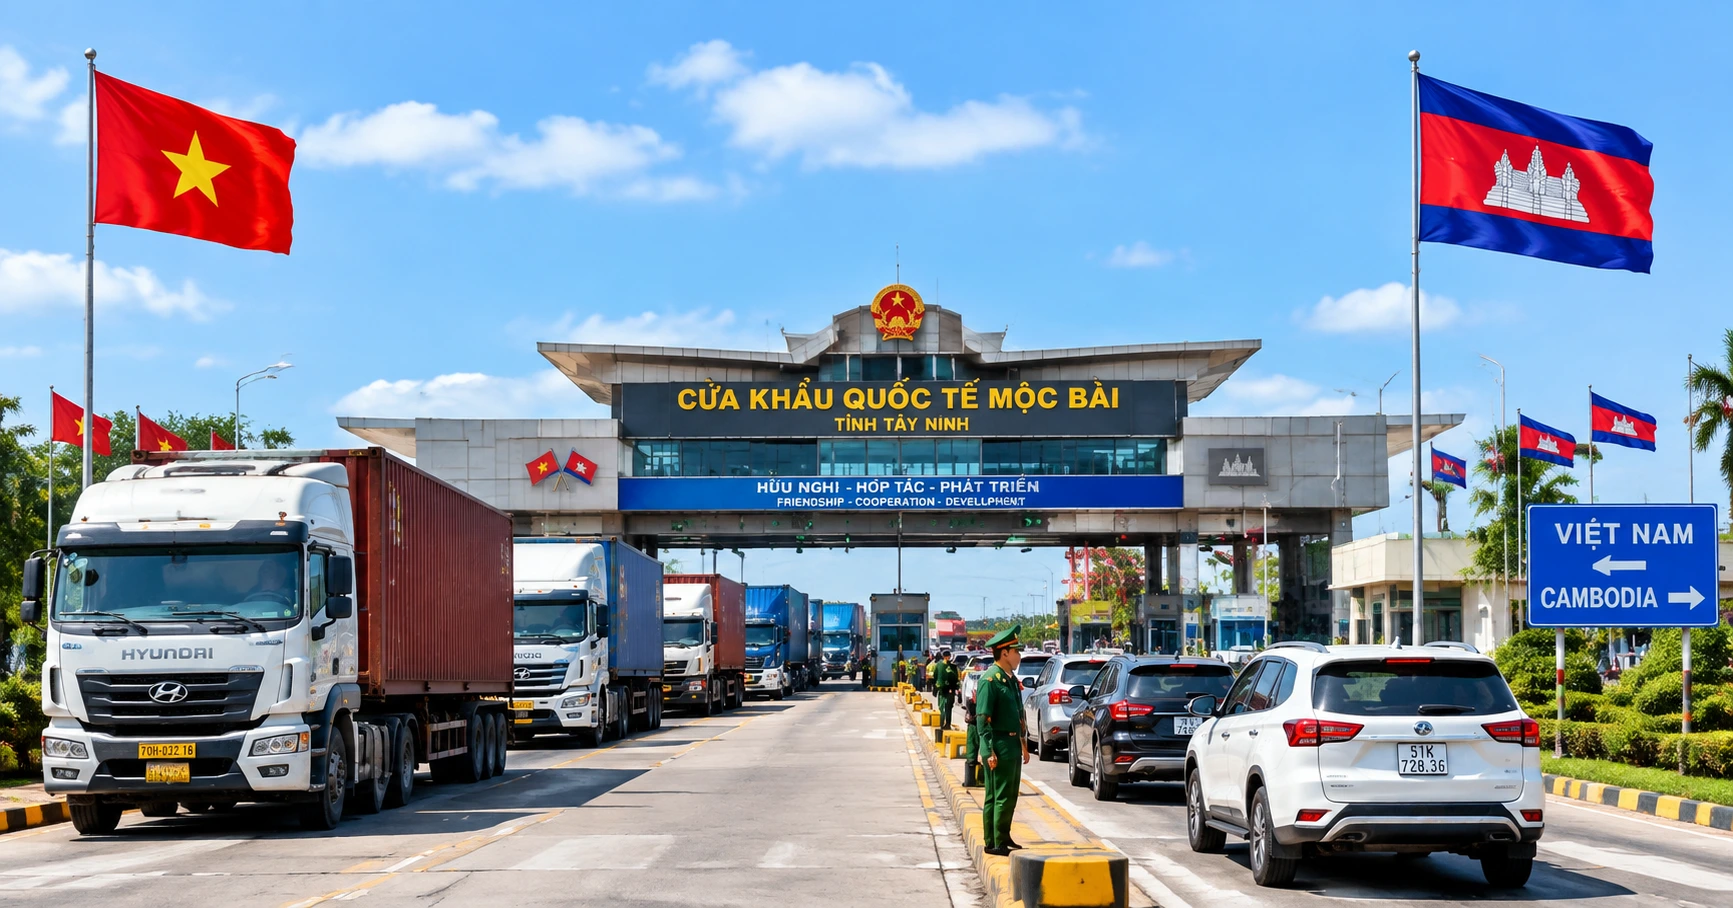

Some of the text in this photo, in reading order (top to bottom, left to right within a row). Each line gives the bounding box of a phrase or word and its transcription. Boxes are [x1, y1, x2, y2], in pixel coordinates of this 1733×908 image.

[677, 376, 1119, 414] CỬA KHẨU QUỐC TẾ MỘC BÀI
[883, 413, 918, 432] TÂY
[925, 415, 969, 432] NINH
[777, 497, 844, 508] FRIENDSHIP
[855, 497, 935, 507] COOPERATION
[1632, 523, 1694, 545] NAM
[1540, 586, 1659, 609] CAMBODIA
[121, 647, 214, 661] HYUNDAI
[1410, 744, 1434, 759] 51K
[1401, 759, 1445, 773] 728.36
